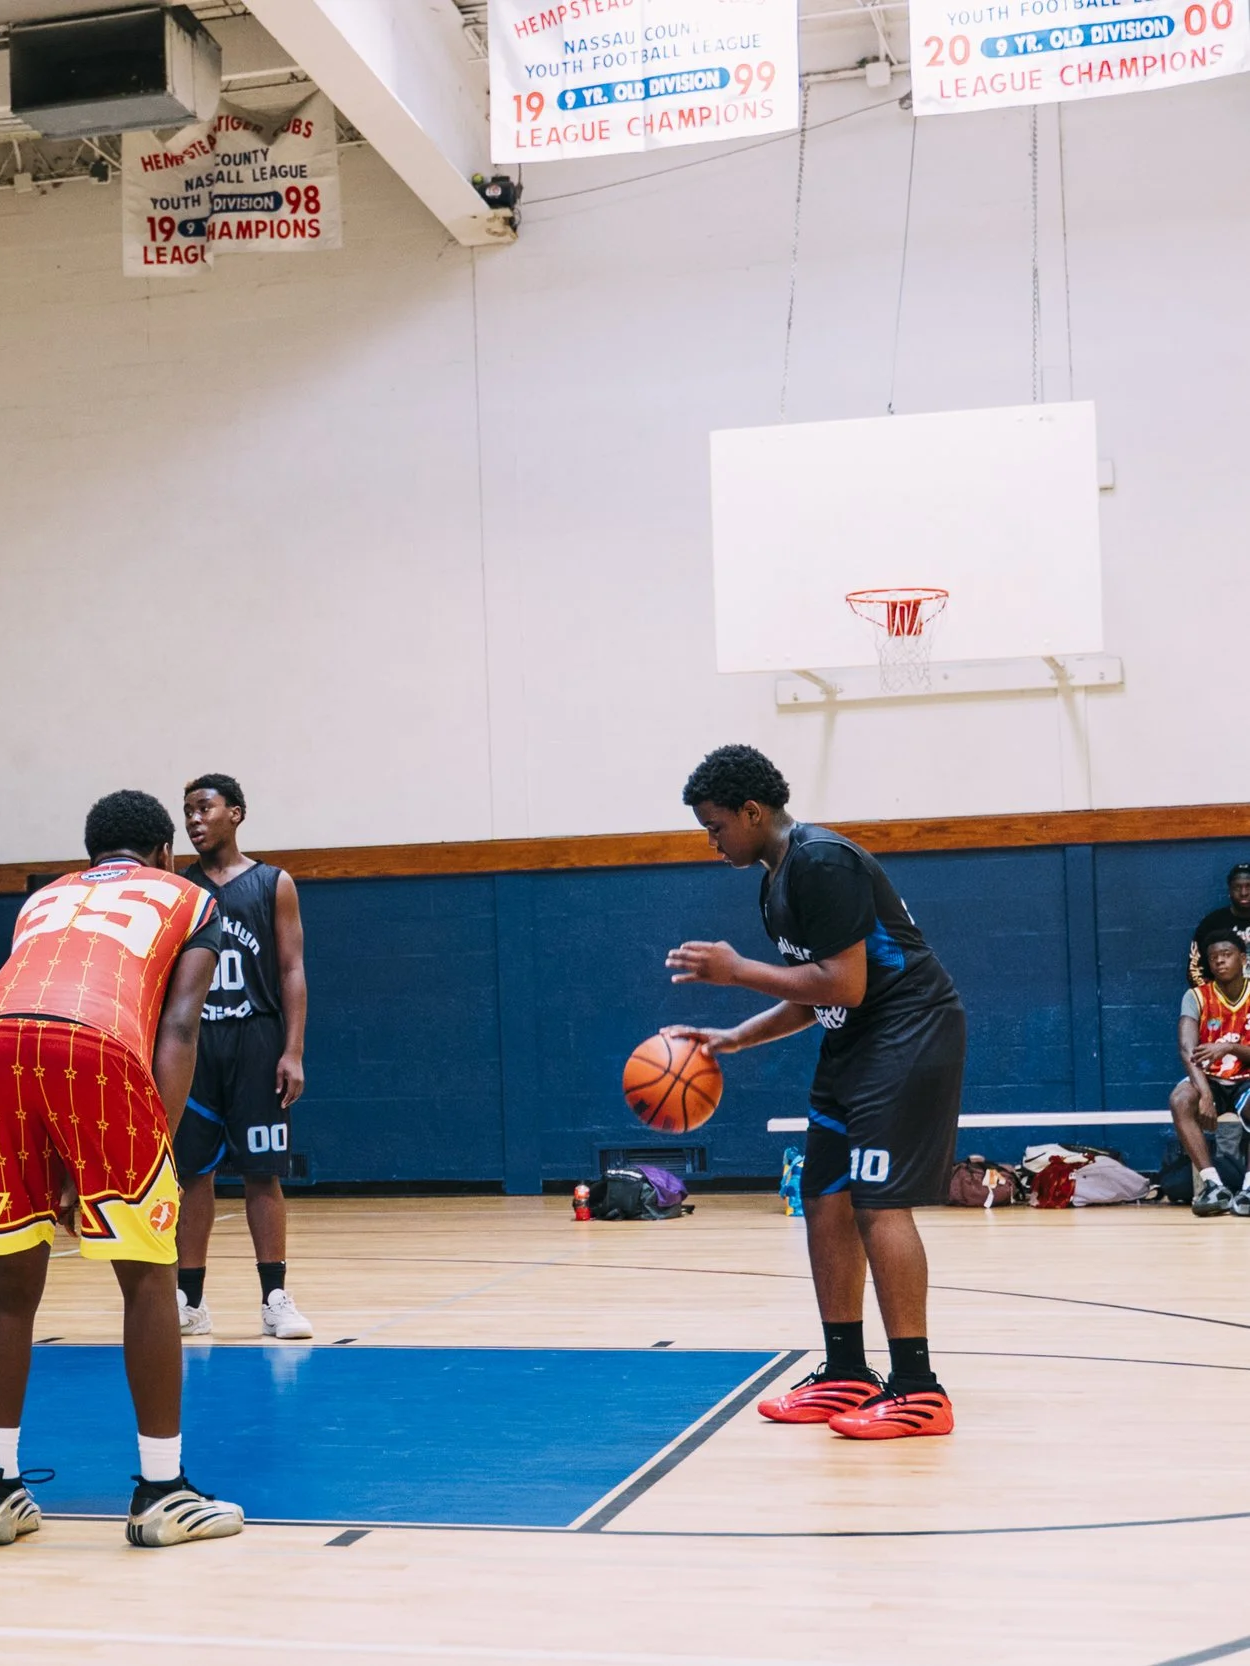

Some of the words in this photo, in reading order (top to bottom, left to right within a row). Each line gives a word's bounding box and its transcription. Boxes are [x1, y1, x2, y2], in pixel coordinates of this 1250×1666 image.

[946, 7, 1010, 27] YOUTH
[564, 31, 636, 56] NASSAU
[924, 35, 971, 68] 20
[995, 37, 1008, 57] 9
[1014, 33, 1043, 53] YR.
[1049, 27, 1084, 49] OLD
[1091, 16, 1169, 44] DIVISION
[1184, 0, 1234, 37] 00
[525, 60, 583, 80] YOUTH
[593, 44, 681, 71] FOOTBALL
[693, 33, 763, 56] LEAGUE
[939, 70, 1043, 99] LEAGUE
[1059, 44, 1224, 86] CHAMPIONS
[513, 91, 545, 123] 19
[564, 92, 577, 109] 9
[583, 86, 609, 105] YR.
[614, 81, 645, 102] OLD
[649, 69, 720, 97] DIVISION
[734, 61, 776, 96] 99
[516, 119, 611, 149] LEAGUE
[627, 98, 775, 137] CHAMPIONS
[252, 165, 308, 182] LEAGUE
[150, 194, 200, 211] YOUTH
[214, 196, 275, 211] DIVISION
[285, 185, 321, 214] 98
[147, 216, 176, 242] 19
[186, 221, 196, 235] 9
[12, 878, 182, 959] 35
[247, 1123, 288, 1153] 00
[850, 1148, 890, 1182] 10
